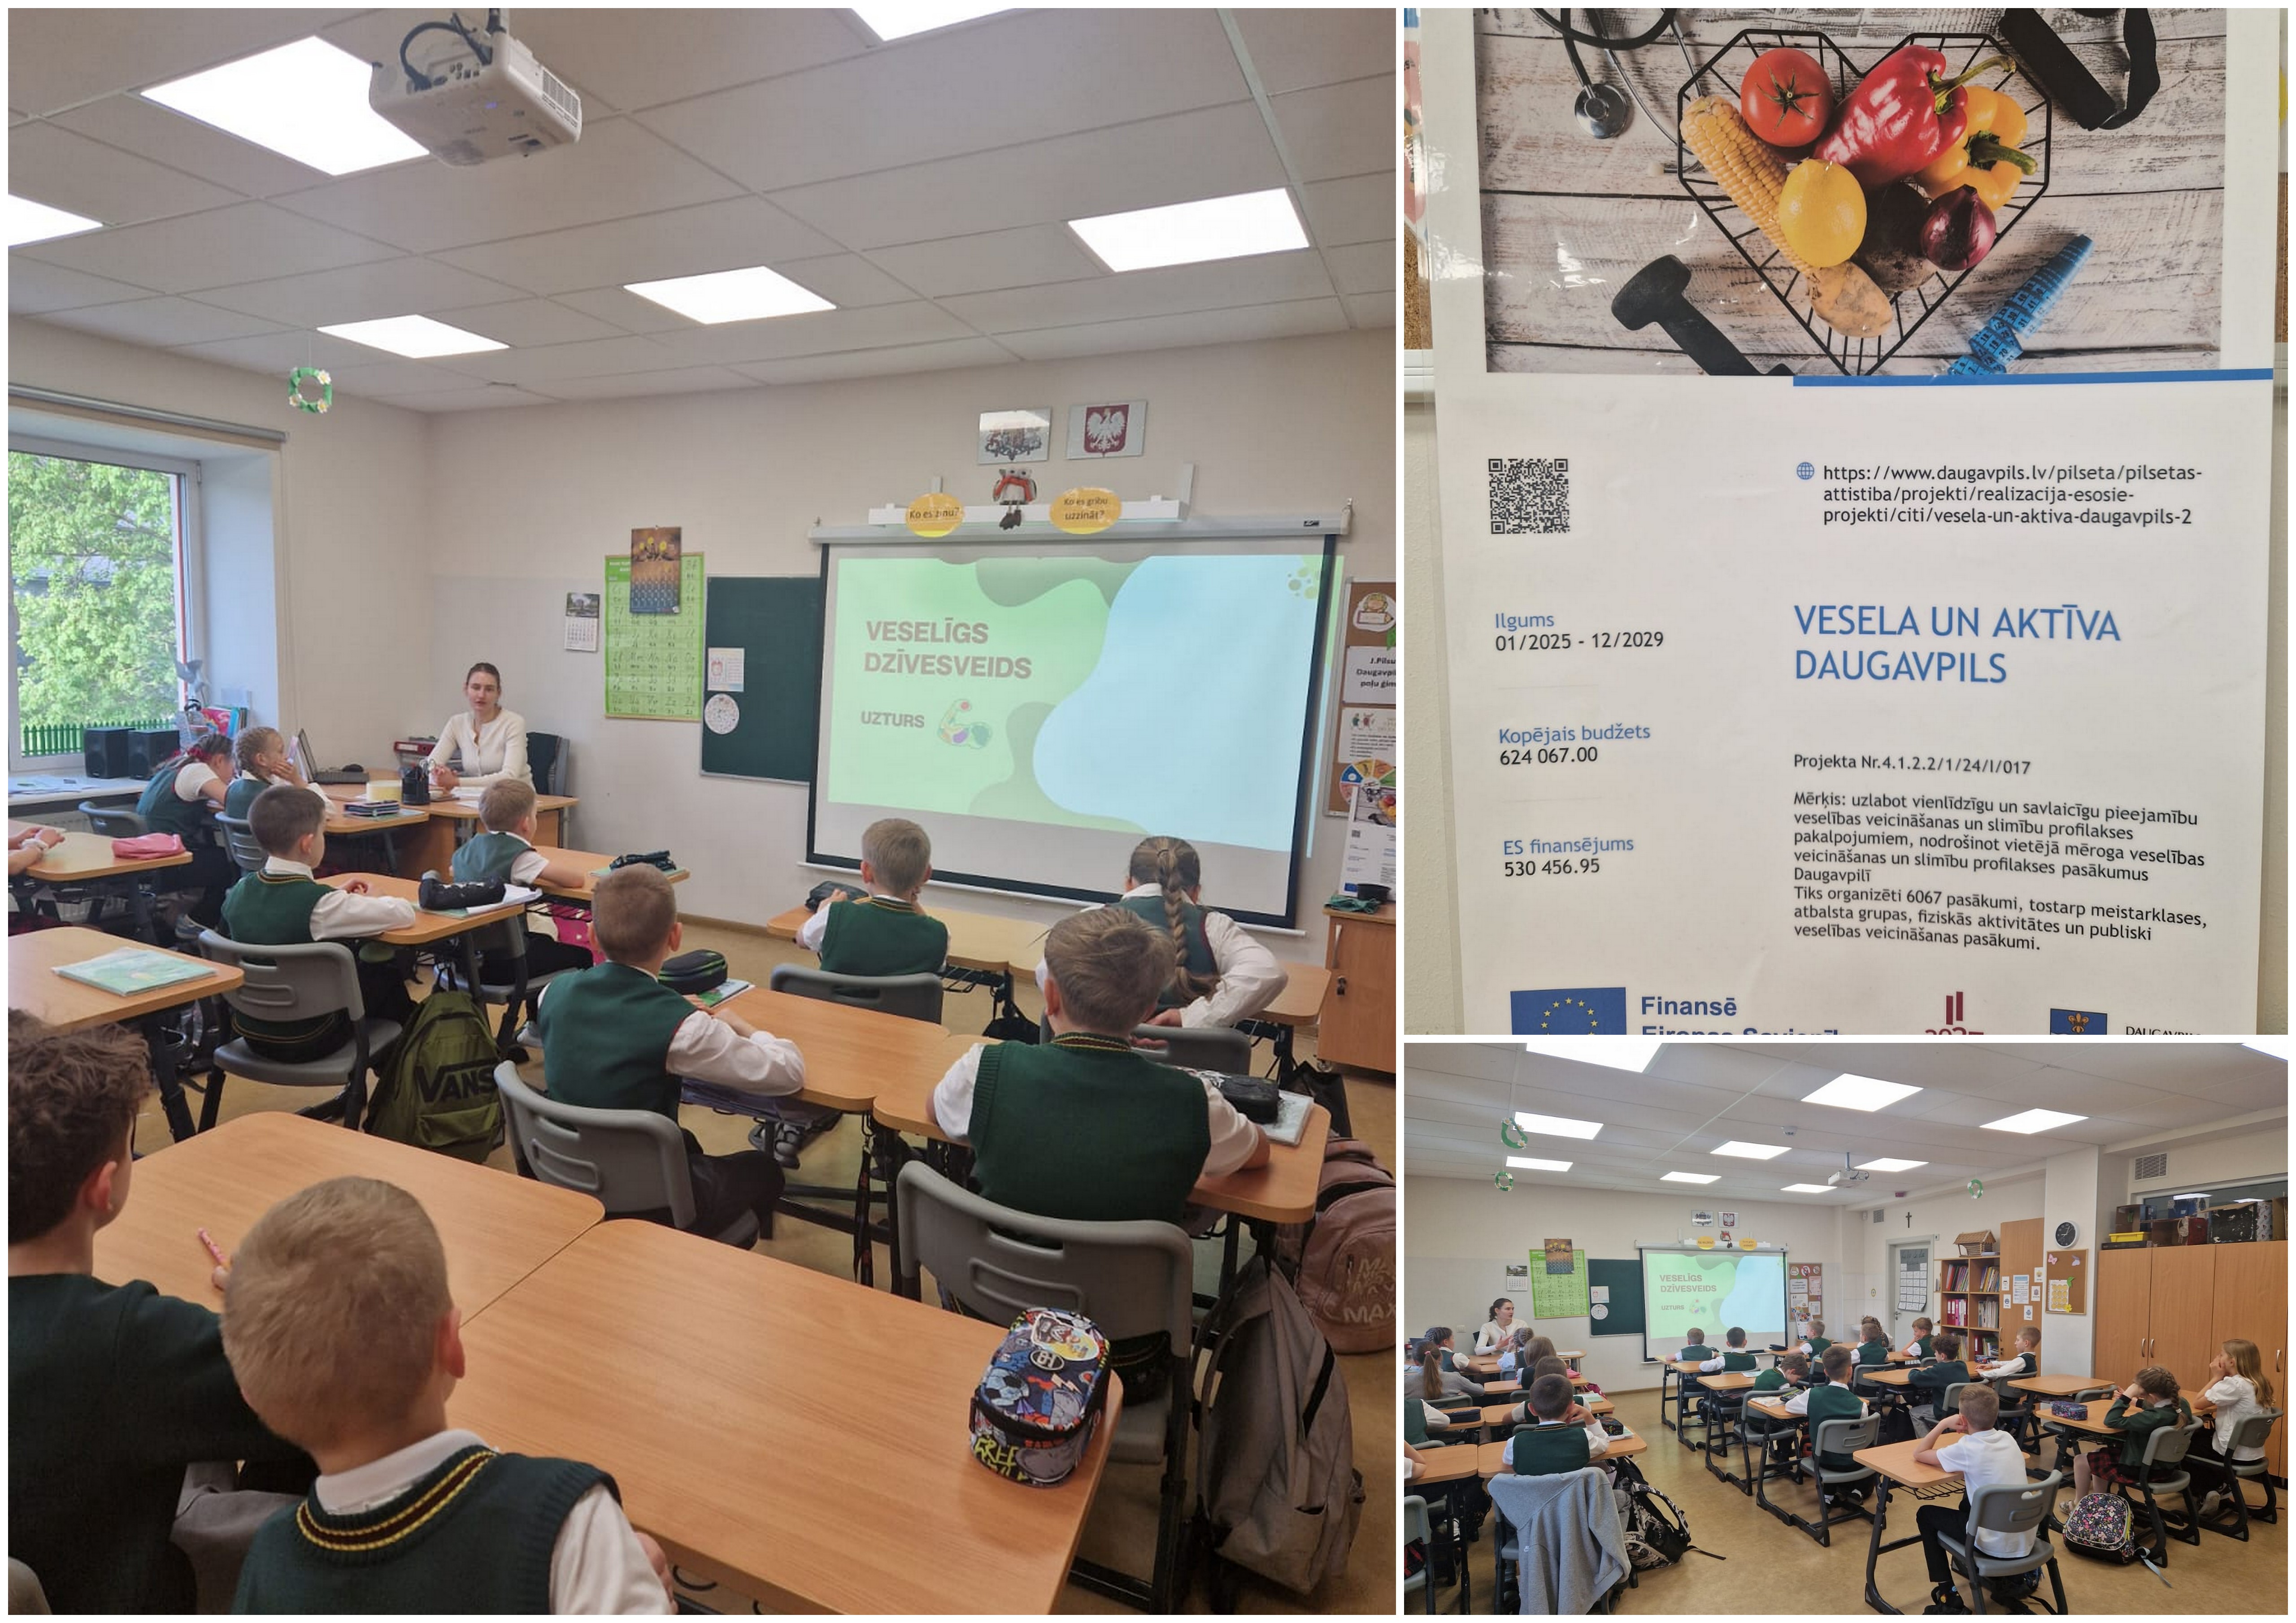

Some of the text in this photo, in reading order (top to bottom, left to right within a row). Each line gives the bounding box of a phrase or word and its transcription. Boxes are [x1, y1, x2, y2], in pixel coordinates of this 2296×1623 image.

[2018, 318, 2027, 327] 31
[1999, 348, 2008, 357] 20
[1824, 464, 2202, 484] https://www.daugavpils.lv/pilseta/pilsetas-
[1824, 486, 2134, 505] attistiba/projekti/realizacija-esosie-
[909, 509, 922, 519] Ko
[1065, 510, 1105, 520] uzzināt?
[1824, 507, 2192, 528] projekti/citi/vesela-un-aktiva-daugavpils-2
[866, 617, 989, 644] VESELĪGS
[1496, 612, 1554, 632] Ilgums
[1794, 604, 2121, 641] VESELA UN AKTĪVA
[1496, 634, 1571, 651] 01/2025
[1592, 631, 1664, 648] 12/2029
[864, 649, 1032, 679] DZĪVESVEIDS
[1796, 650, 2007, 684] DAUGAVPILS
[861, 711, 925, 728] UZTURS
[1499, 723, 1651, 747] Kopējais budžets
[1500, 746, 1598, 765] 624 067.00
[1794, 754, 1857, 771] Projekta
[1794, 791, 2197, 825] Mērķis: uzlabot vienlīdzīgu un savlaicīgu pieejamību
[1794, 811, 2133, 840] veselības veicināšanas un slimību profilakses
[1504, 837, 1634, 855] ES finansējums
[1794, 829, 2205, 866] pakalpojumiem, nodrošinot vietējā mēroga veselības
[1505, 858, 1600, 877] 530 456.95
[1794, 849, 2148, 881] veicināšanas un slimību profilakses pasākumus
[1794, 867, 1871, 885] Daugavpilī
[1794, 886, 2206, 930] Tiks organizēti 6067 pasākumi, tostarp meistarklases,
[1794, 904, 2151, 940] atbalsta grupas, fiziskās aktivitātes un publiski
[1794, 923, 2040, 950] veselības veicināšanas pasākumi.
[1641, 996, 1737, 1016] Finansē
[414, 1057, 496, 1102] VANS
[1659, 1273, 1703, 1282] VESELĪGS
[1661, 1284, 1717, 1292] DZĪVESVEIDS
